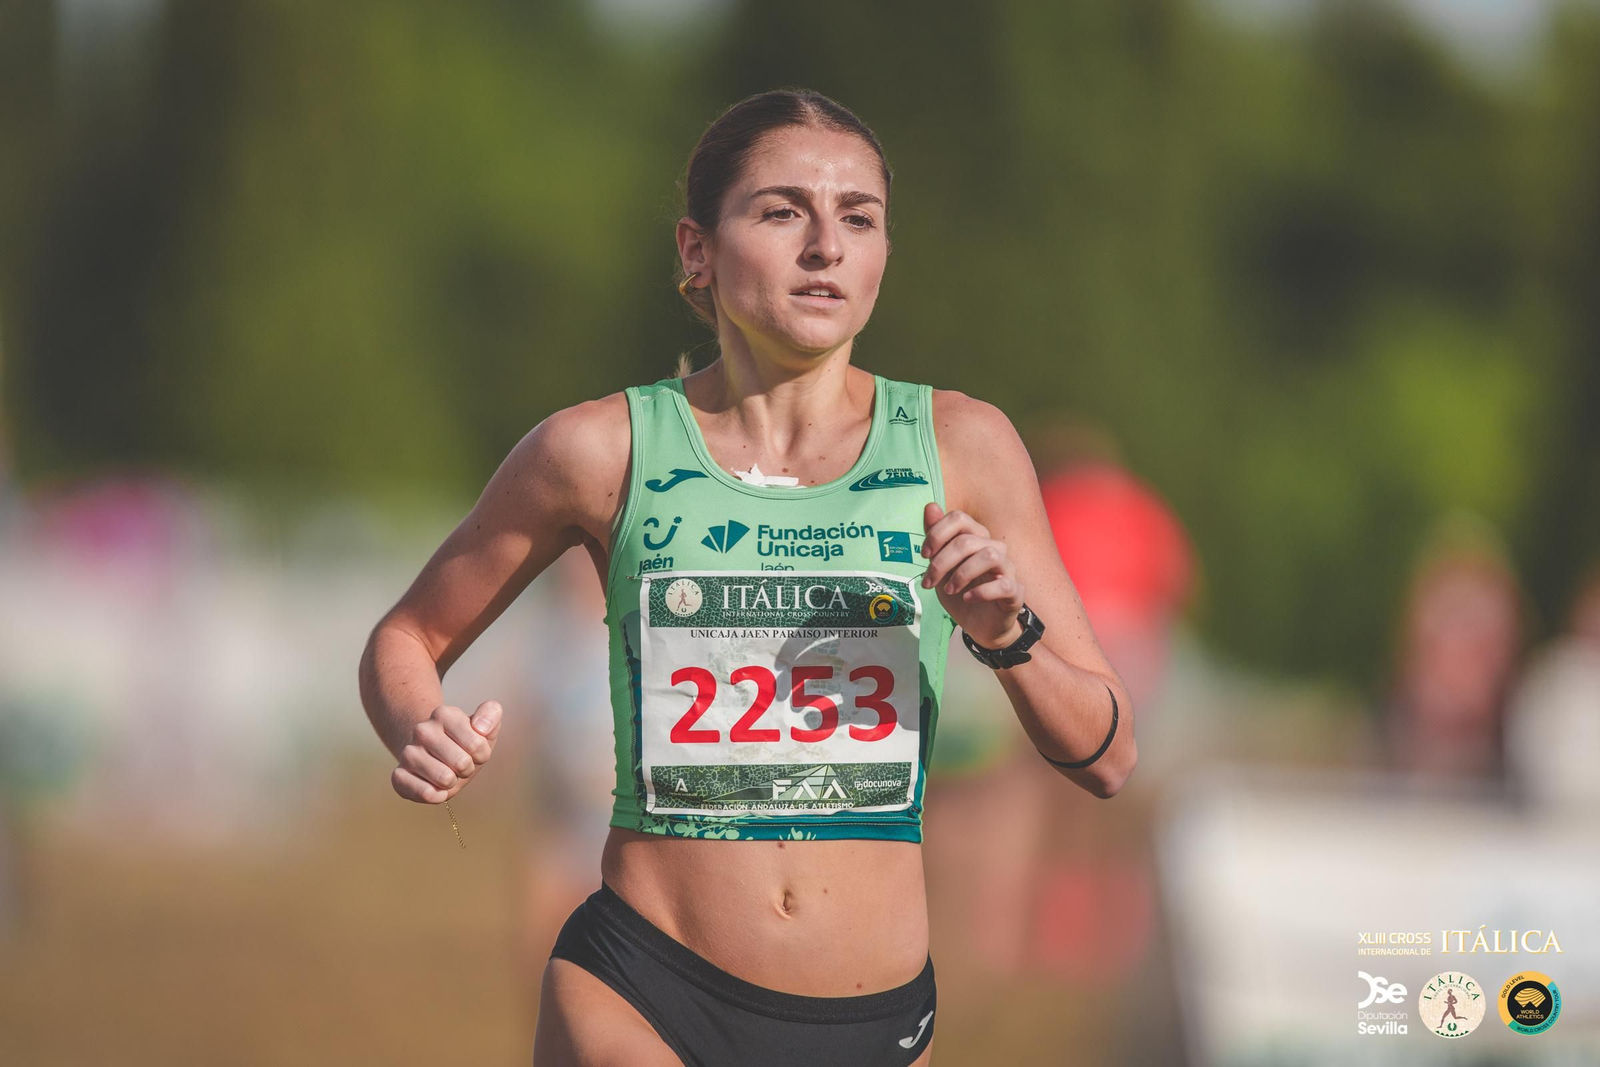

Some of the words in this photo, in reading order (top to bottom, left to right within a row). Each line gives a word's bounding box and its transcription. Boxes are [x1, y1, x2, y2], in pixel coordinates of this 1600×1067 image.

[757, 521, 875, 540] Fundación
[757, 540, 844, 562] Unicaja
[637, 553, 674, 576] jaén
[722, 578, 850, 610] ITÁLICA
[690, 629, 739, 639] UNICAJA
[741, 629, 770, 639] JAEN
[772, 629, 822, 639] PARAISO
[823, 629, 879, 639] INTERIOR
[670, 665, 898, 744] 2253
[863, 779, 902, 788] docunova
[752, 803, 795, 811] ANDALUZA
[799, 803, 809, 811] DE
[811, 802, 854, 811] ATLETISMO
